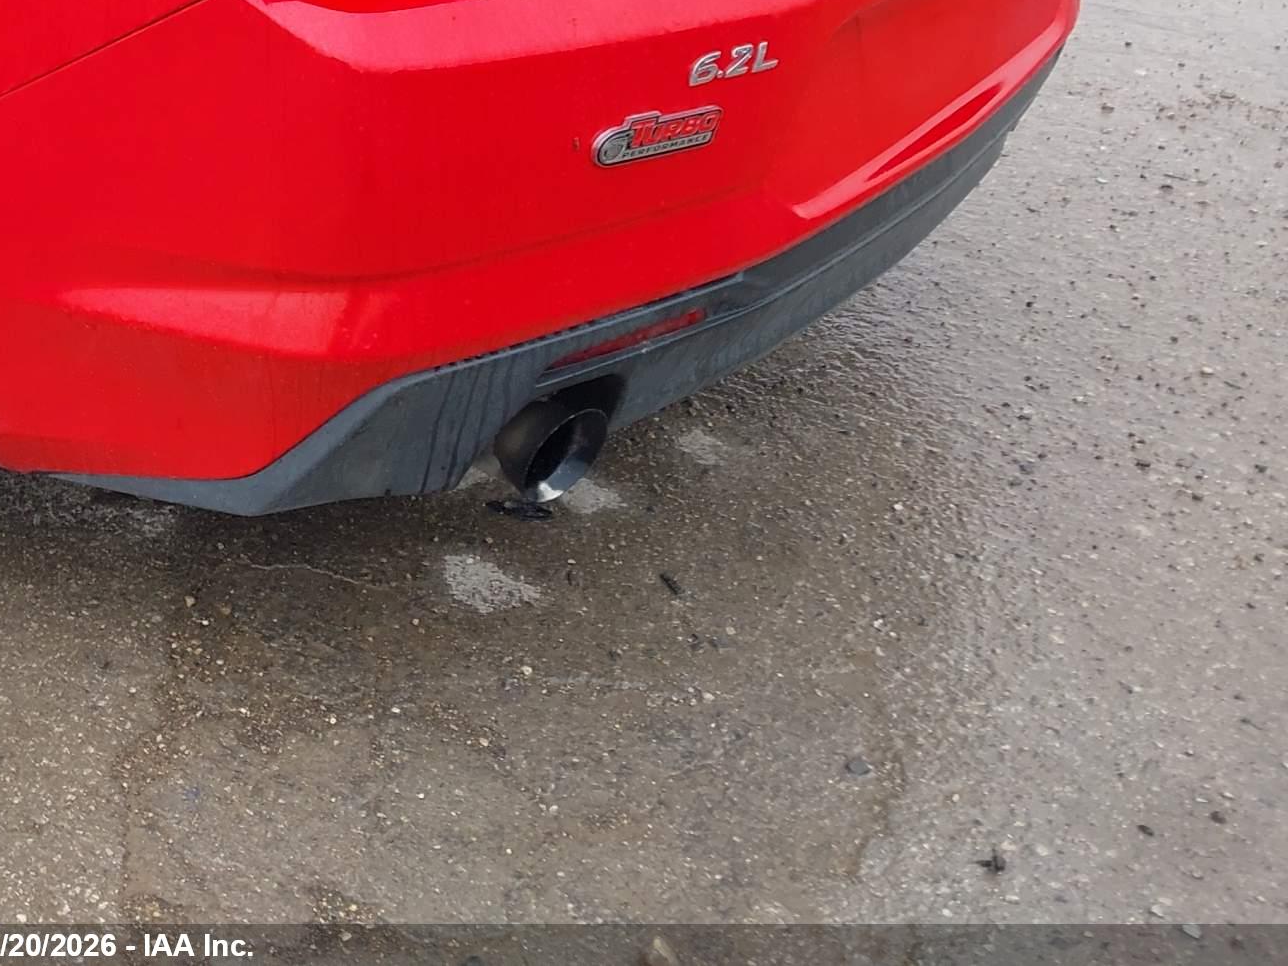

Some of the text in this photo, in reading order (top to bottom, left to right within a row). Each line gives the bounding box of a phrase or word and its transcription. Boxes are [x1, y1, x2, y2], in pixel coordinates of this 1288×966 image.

[689, 42, 779, 87] 6.2L
[622, 135, 709, 159] PERFORMANCE
[630, 112, 722, 149] TURBO
